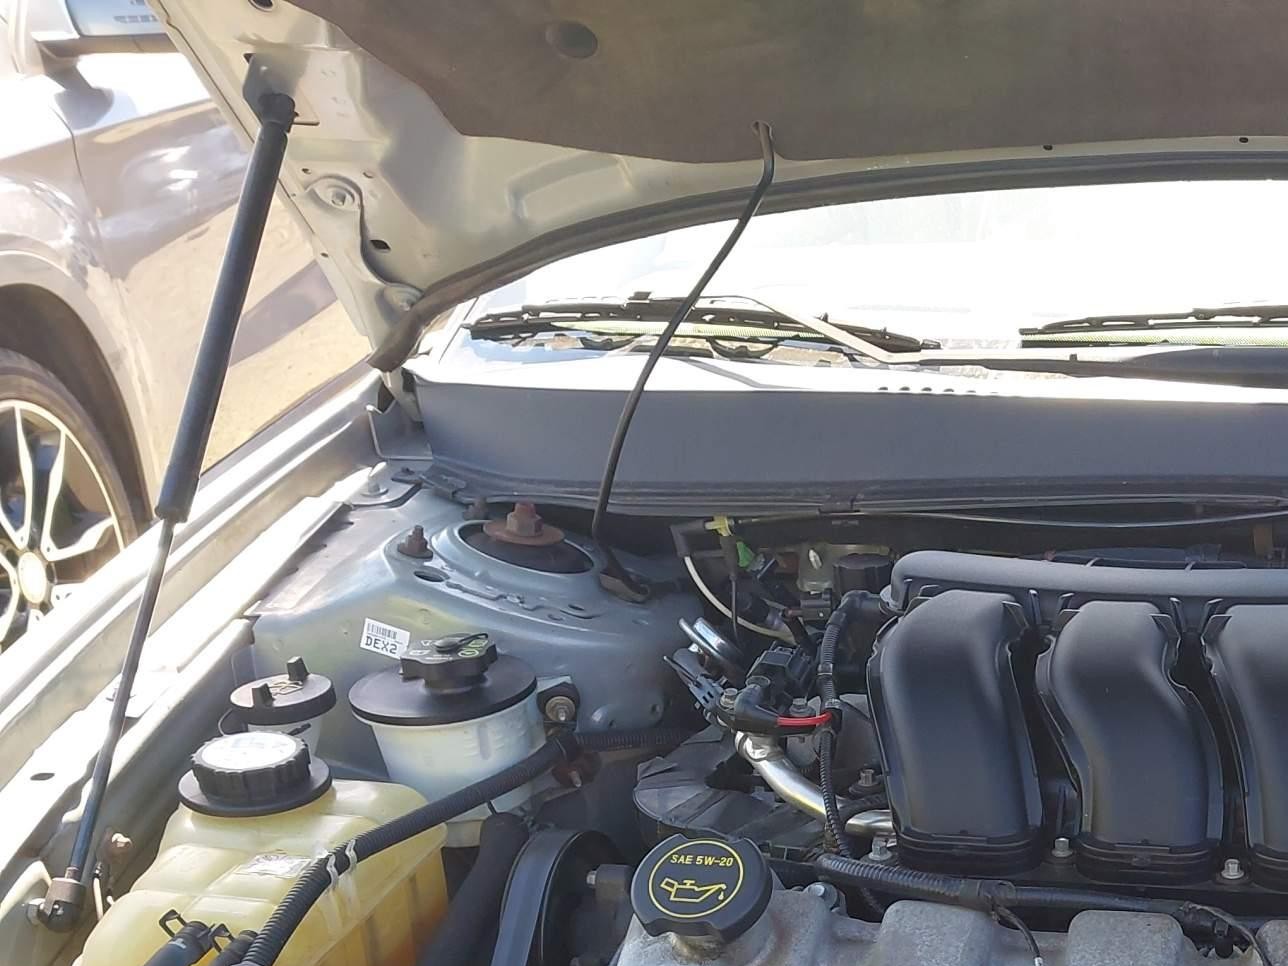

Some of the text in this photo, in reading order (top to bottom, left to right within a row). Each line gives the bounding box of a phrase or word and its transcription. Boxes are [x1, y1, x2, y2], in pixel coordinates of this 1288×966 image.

[364, 636, 398, 655] DEX2
[670, 854, 734, 867] SAE 5W-20
